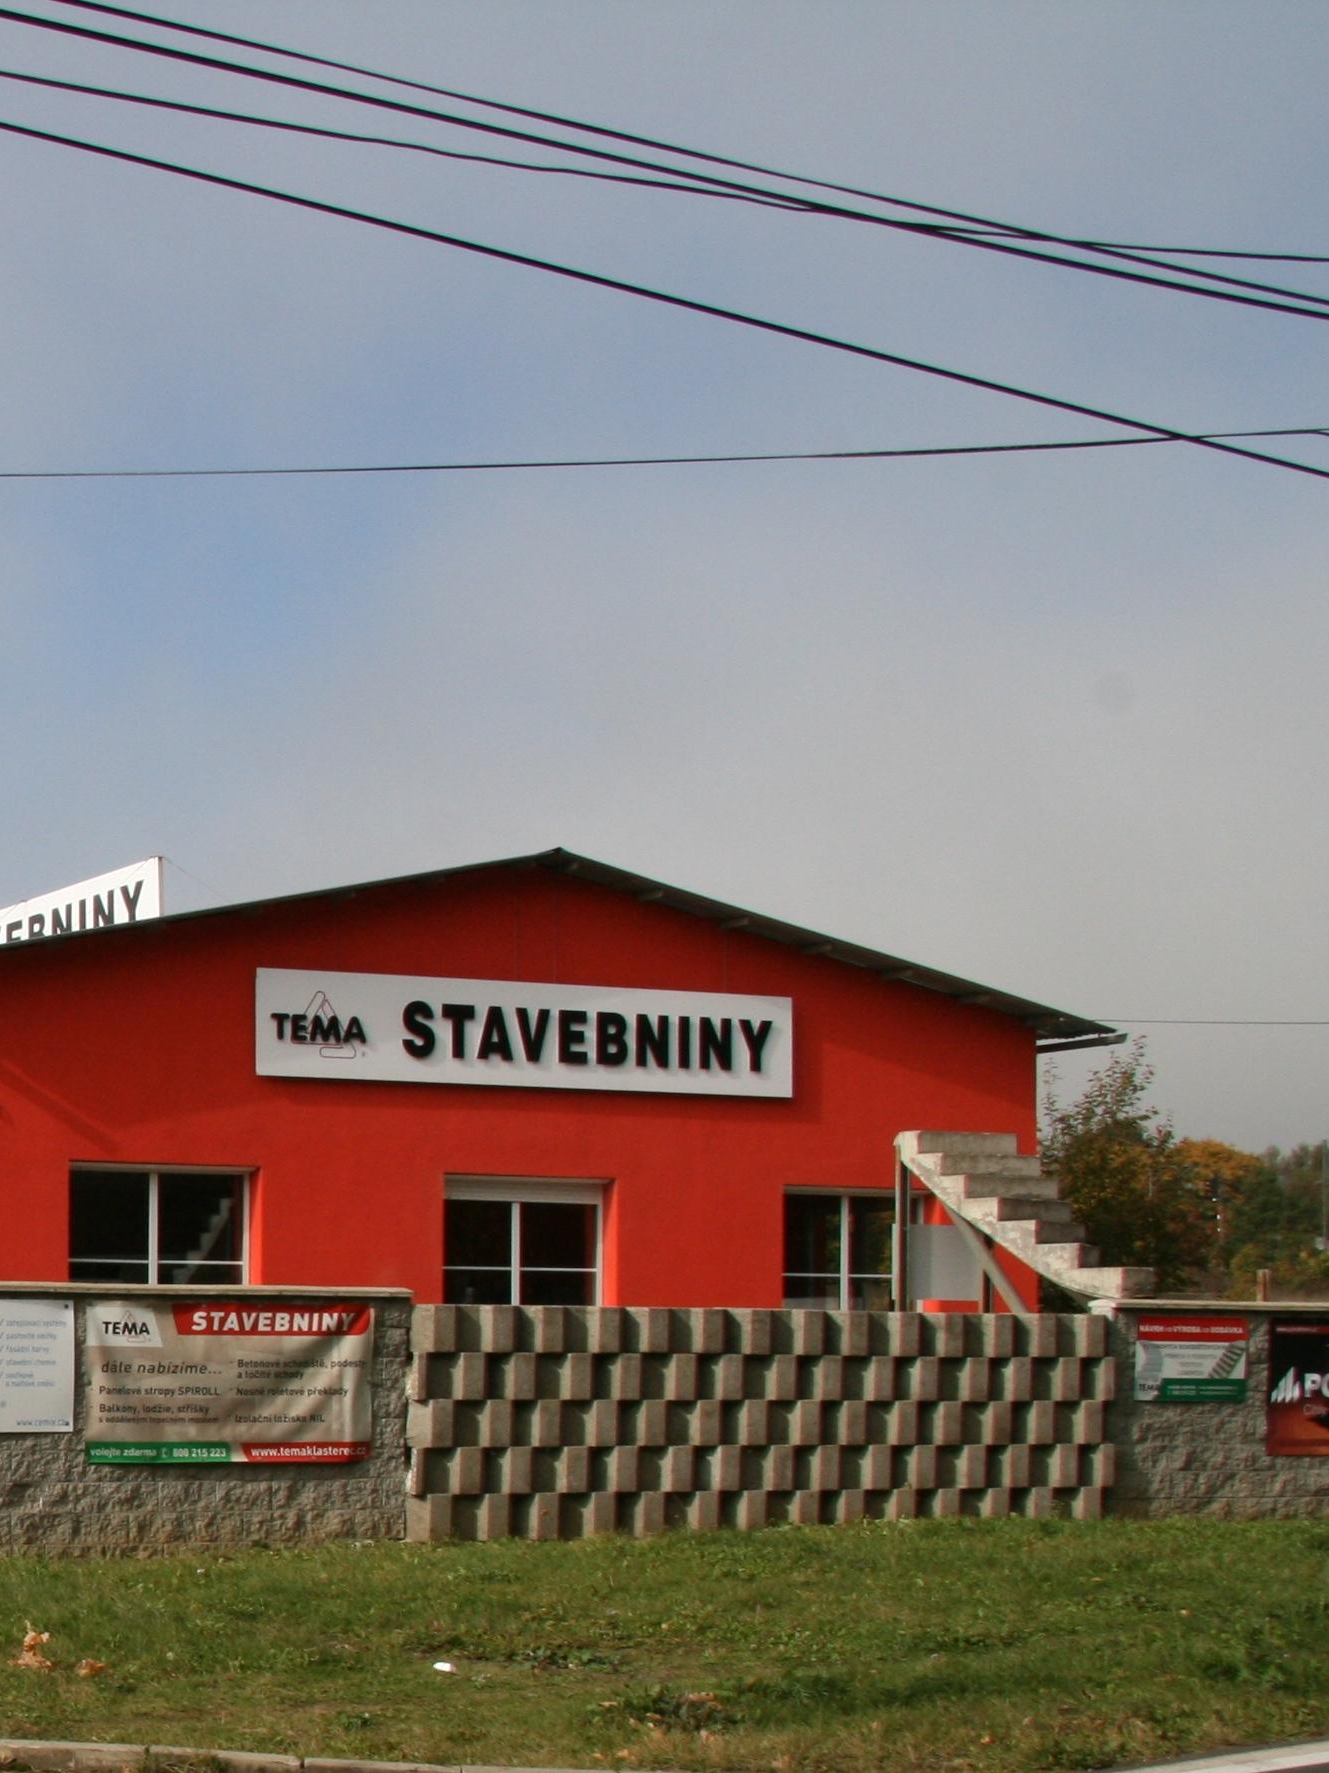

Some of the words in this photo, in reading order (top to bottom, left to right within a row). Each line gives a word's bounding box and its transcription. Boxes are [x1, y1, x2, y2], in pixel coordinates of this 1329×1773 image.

[270, 1012, 368, 1044] TEMA
[401, 1000, 773, 1073] STAVEBNINY
[101, 1320, 151, 1336] TEMA
[190, 1310, 357, 1333] STAVEBNINY
[101, 1361, 132, 1374] dále
[144, 1385, 176, 1398] stropy
[177, 1386, 221, 1397] SPIROLL
[123, 1447, 158, 1457] zdarma
[191, 1447, 208, 1458] 215
[210, 1447, 227, 1458] 223
